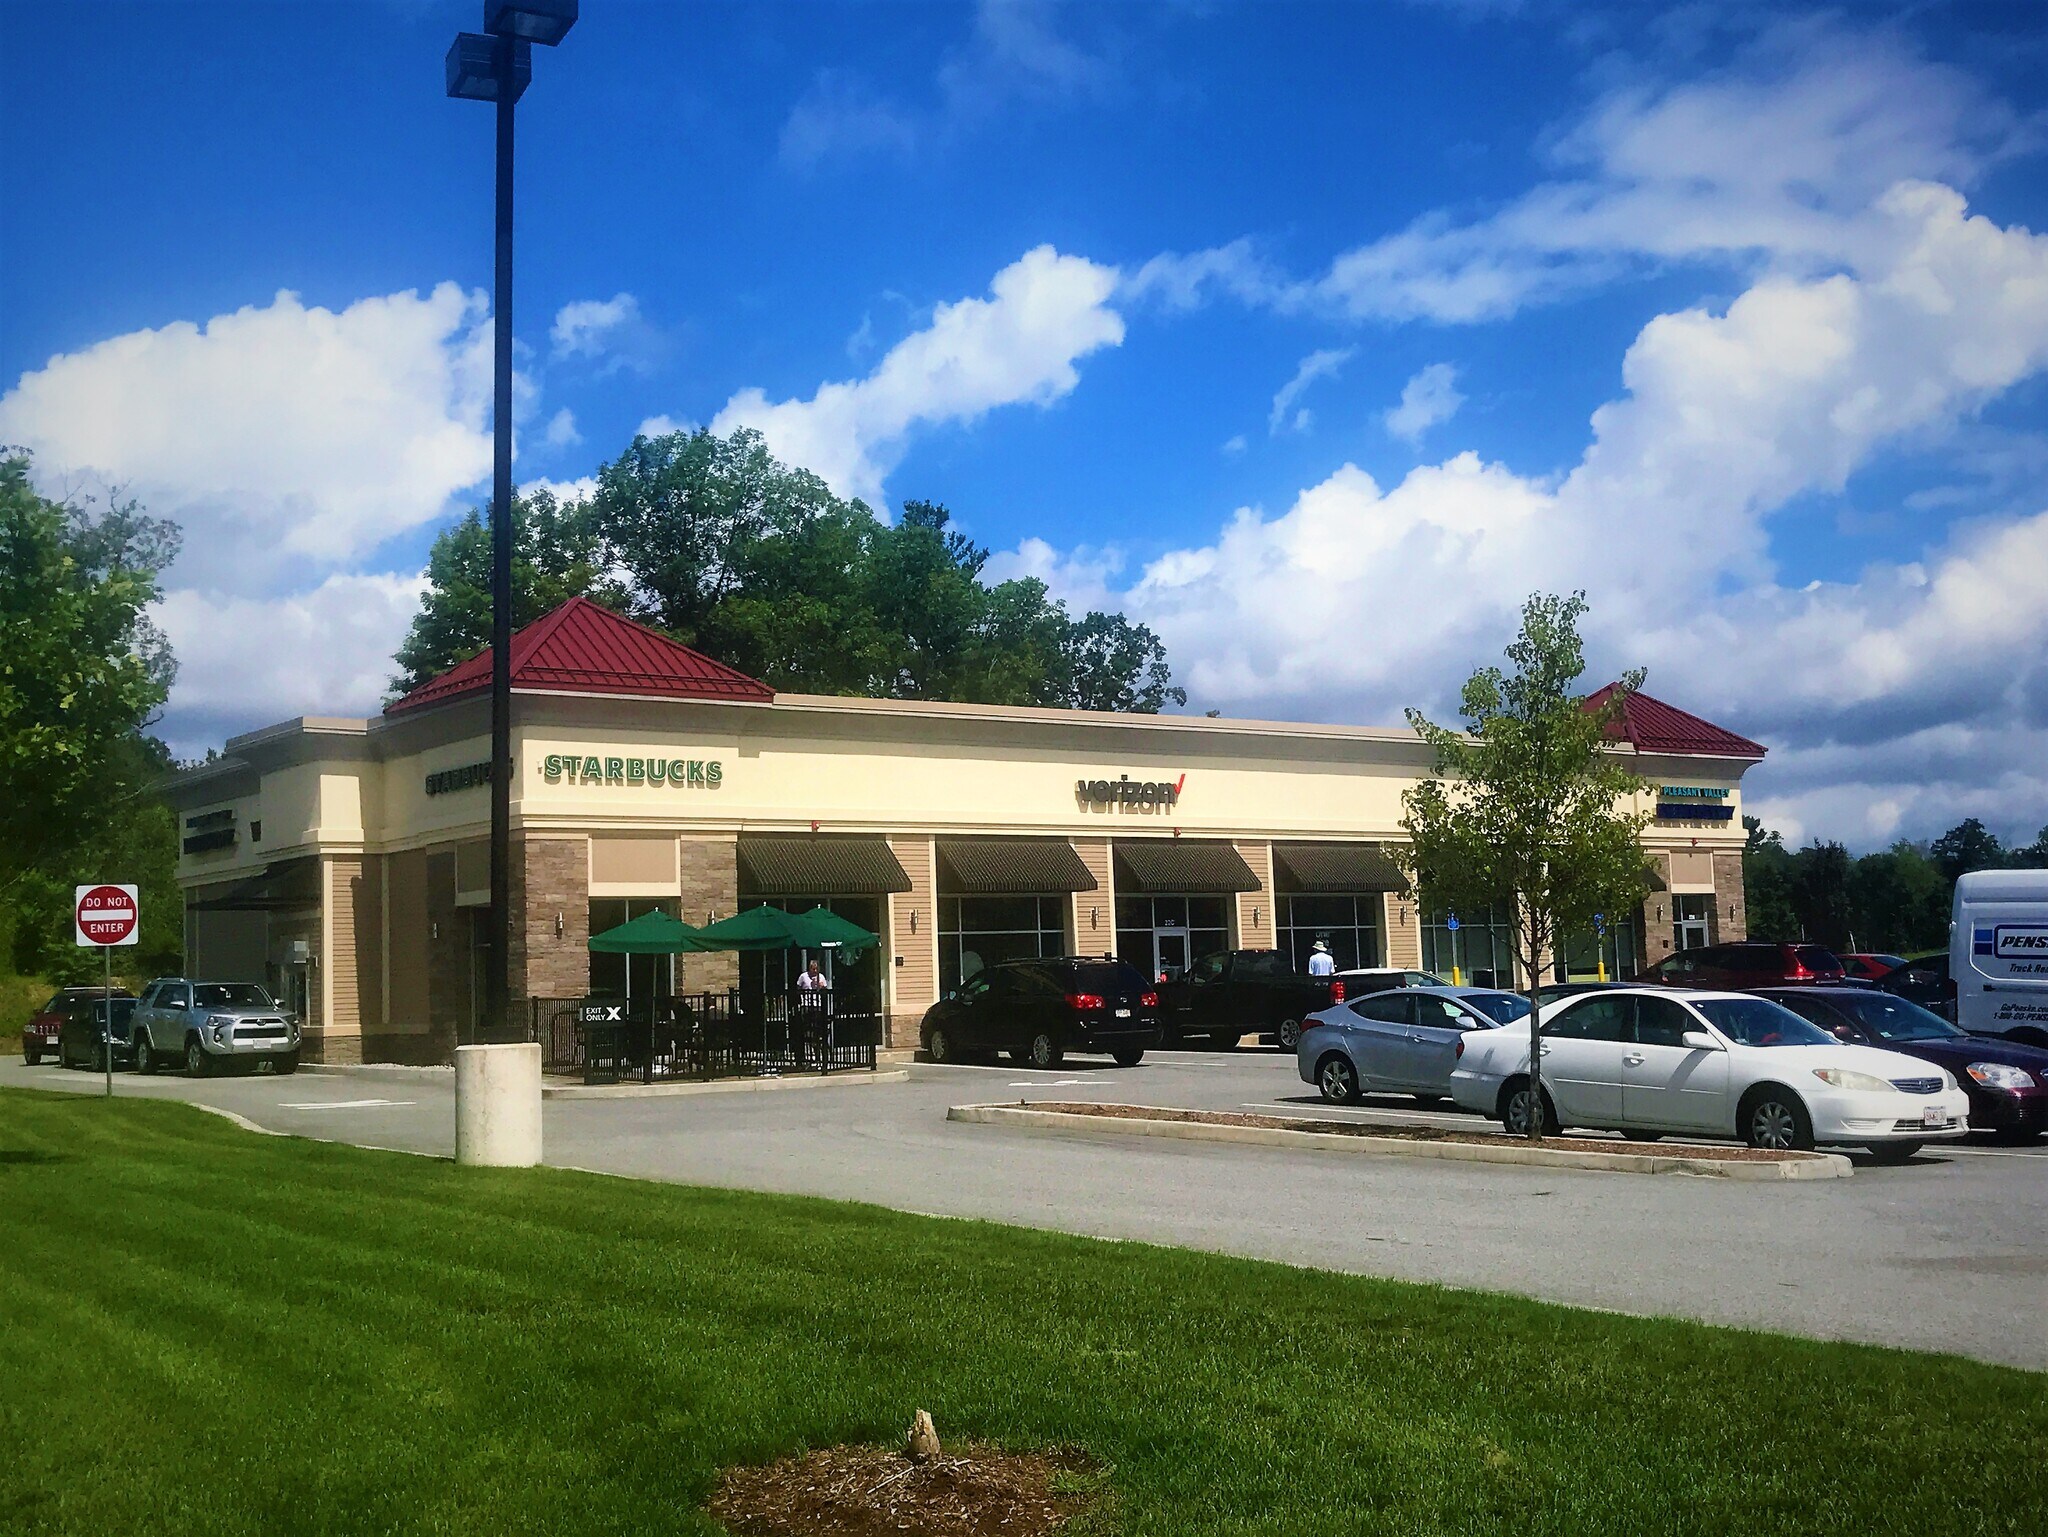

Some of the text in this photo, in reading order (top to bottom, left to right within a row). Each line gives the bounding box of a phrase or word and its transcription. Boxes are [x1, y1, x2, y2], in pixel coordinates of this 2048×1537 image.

[544, 754, 722, 783] STARBUCKS
[1077, 774, 1176, 803] verizon
[86, 897, 128, 907] DO NOT
[90, 923, 124, 934] ENTER
[2000, 935, 2048, 948] PENS
[2009, 963, 2033, 973] Truck
[585, 1014, 606, 1022] ONLY
